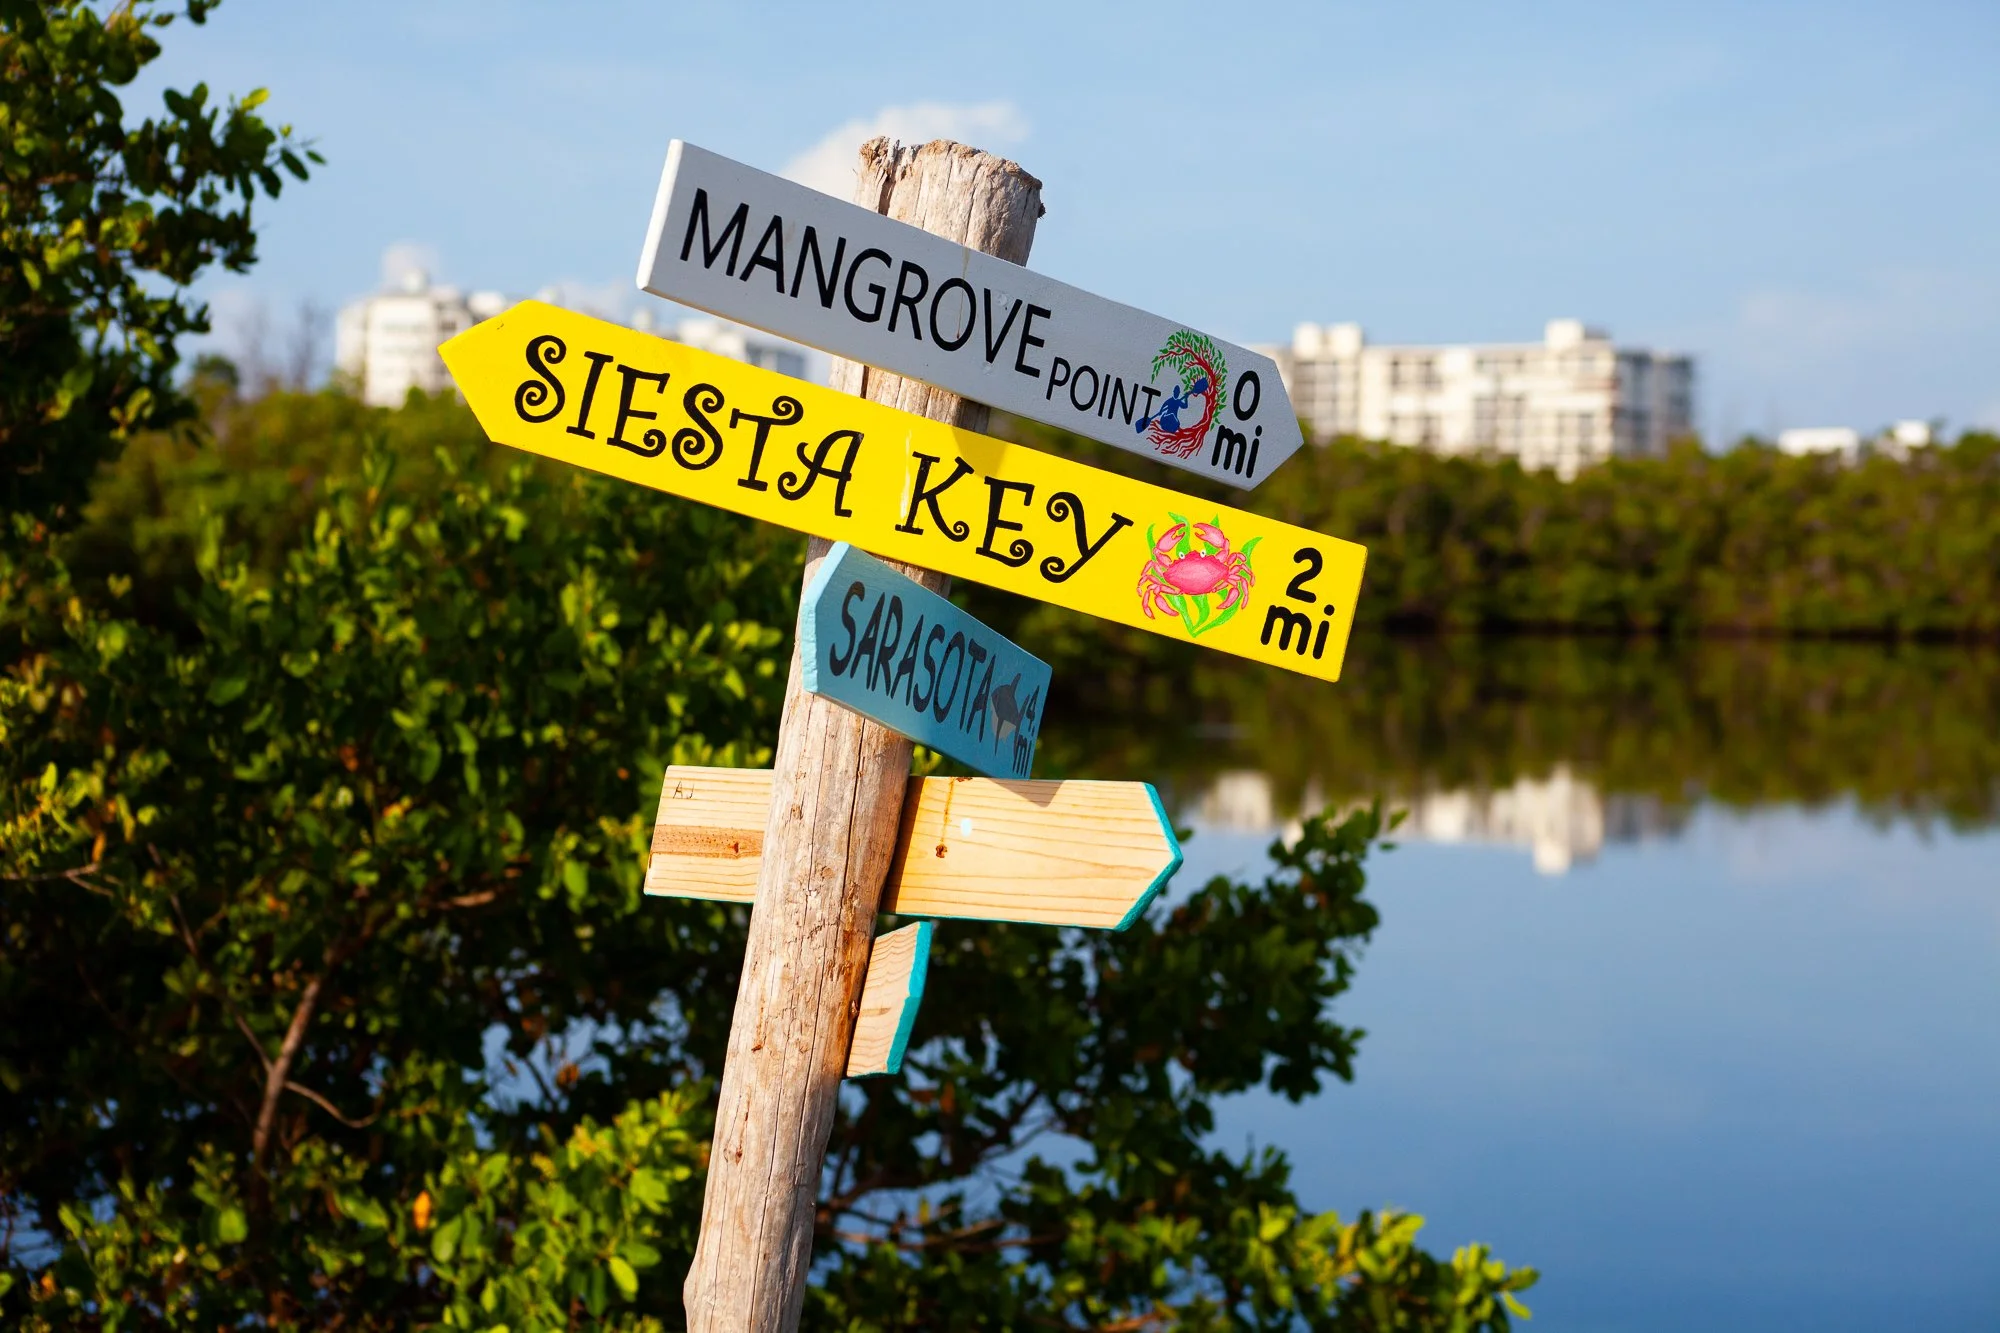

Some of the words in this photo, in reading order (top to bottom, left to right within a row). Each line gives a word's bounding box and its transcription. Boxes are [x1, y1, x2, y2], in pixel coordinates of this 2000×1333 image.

[679, 187, 1052, 379] MANGROVE
[1046, 356, 1162, 430] POINT
[514, 335, 863, 518] SIESTA
[895, 451, 1134, 584] KEY
[1211, 424, 1263, 479] mi
[1286, 547, 1323, 603] 2
[1260, 604, 1335, 660] mi
[829, 581, 997, 743] SARASOTA
[1025, 685, 1040, 732] 4
[1012, 726, 1036, 778] mi
